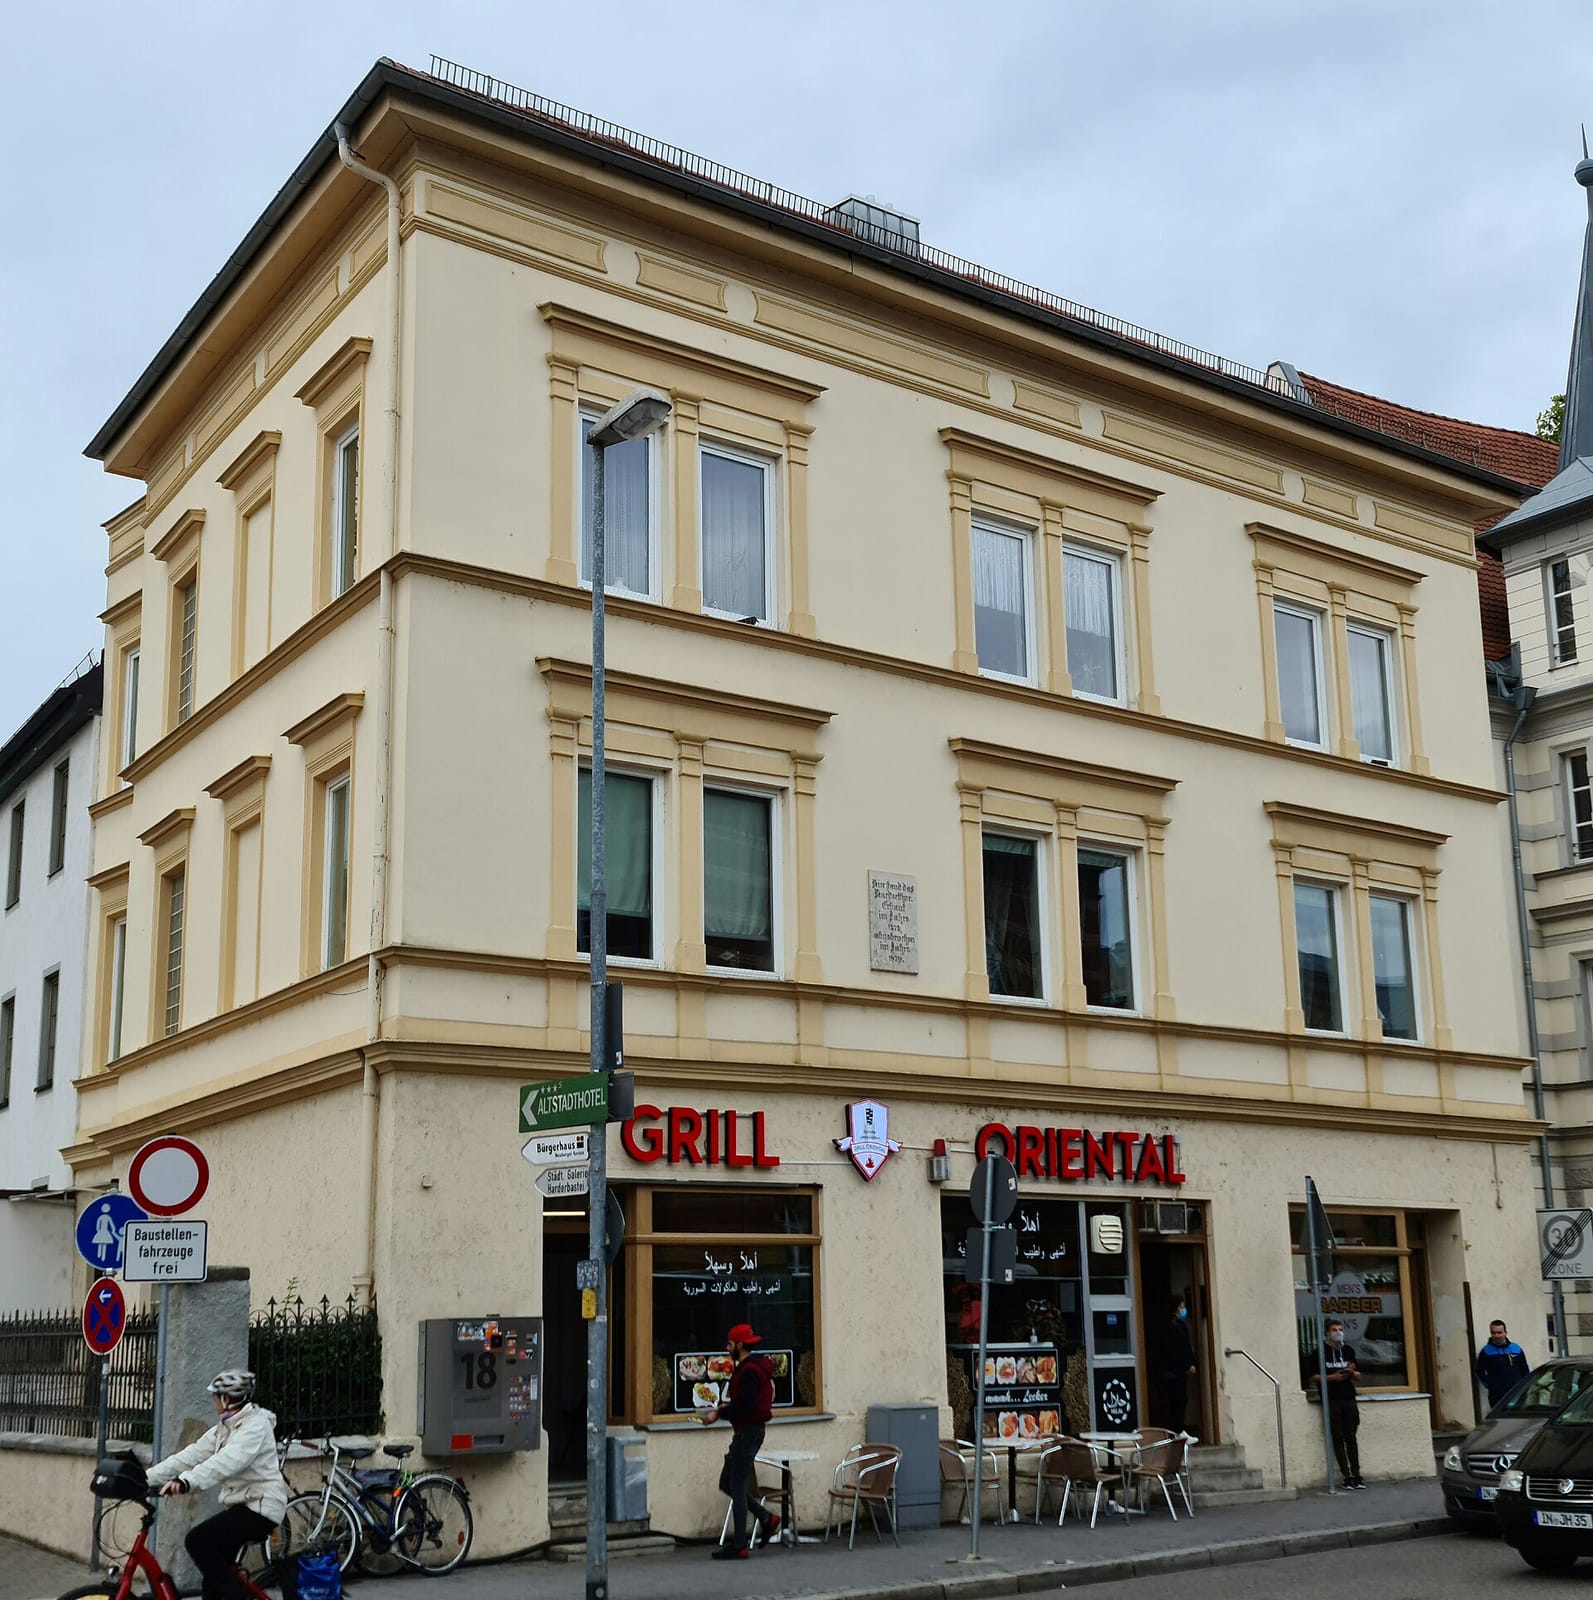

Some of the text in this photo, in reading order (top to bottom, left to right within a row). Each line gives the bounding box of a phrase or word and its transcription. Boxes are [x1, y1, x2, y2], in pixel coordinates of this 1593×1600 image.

[537, 1087, 606, 1115] ALTSTADTHOTEL
[620, 1103, 781, 1168] GRILL
[536, 1141, 575, 1155] Bürgerhaus
[975, 1122, 1186, 1184] ORIENTAL
[567, 1168, 588, 1180] Galerie
[547, 1181, 585, 1194] Harderbastei
[134, 1227, 199, 1241] Baustellen-
[138, 1244, 194, 1261] fahrzeuge
[153, 1261, 178, 1275] frei
[1551, 1262, 1583, 1275] ZONE
[1320, 1297, 1382, 1314] BARBER
[460, 1352, 497, 1391] 18
[1541, 1512, 1587, 1527] IN JH 35
